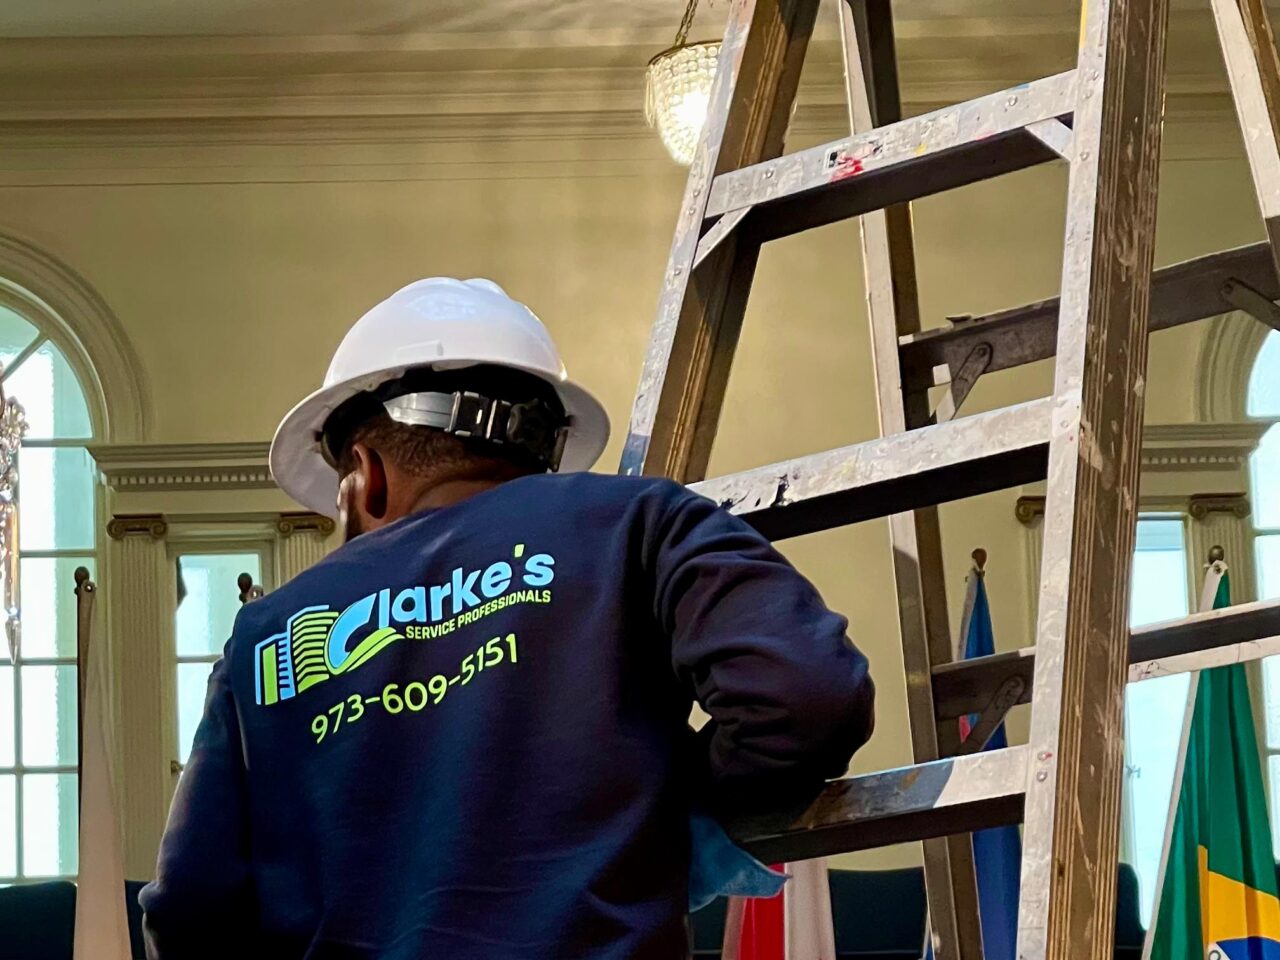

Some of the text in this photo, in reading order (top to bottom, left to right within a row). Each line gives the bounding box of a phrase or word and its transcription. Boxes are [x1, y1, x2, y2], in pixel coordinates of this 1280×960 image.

[326, 544, 555, 670] Clarke's
[405, 590, 551, 639] SERVICE PROFESSIONALS
[311, 633, 517, 743] 973-609-5151
